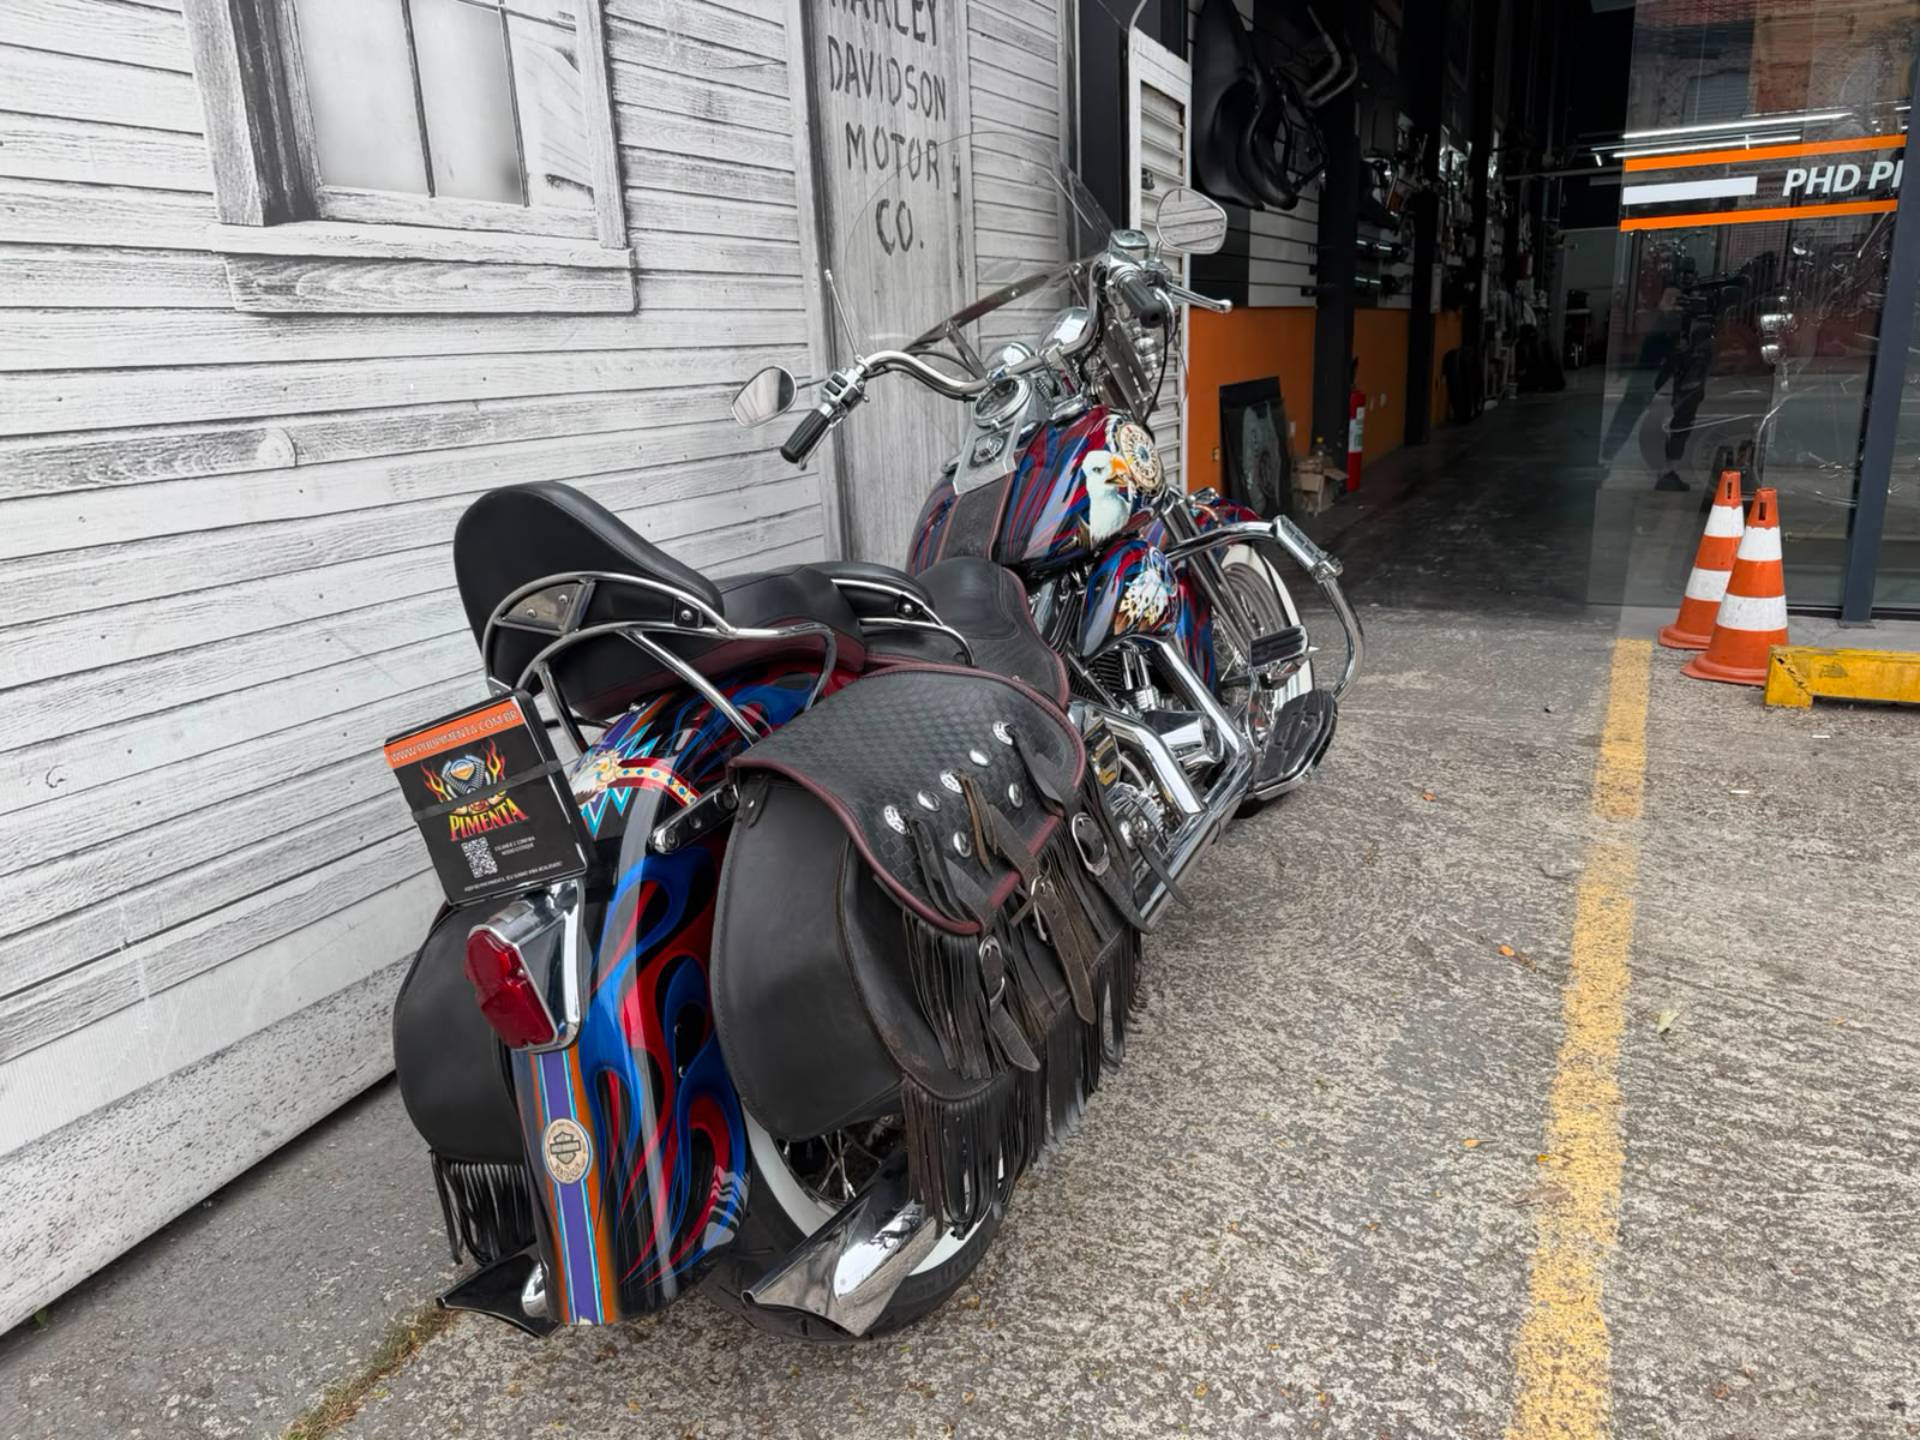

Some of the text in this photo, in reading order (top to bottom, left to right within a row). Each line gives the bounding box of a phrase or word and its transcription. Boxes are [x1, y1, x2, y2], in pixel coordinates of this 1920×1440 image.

[831, 0, 936, 46] LEY
[827, 35, 946, 121] DAVIDSON
[845, 121, 940, 190] MOTOR
[1782, 164, 1861, 197] PHD
[876, 199, 924, 256] CO.
[448, 797, 529, 843] PIMENTA
